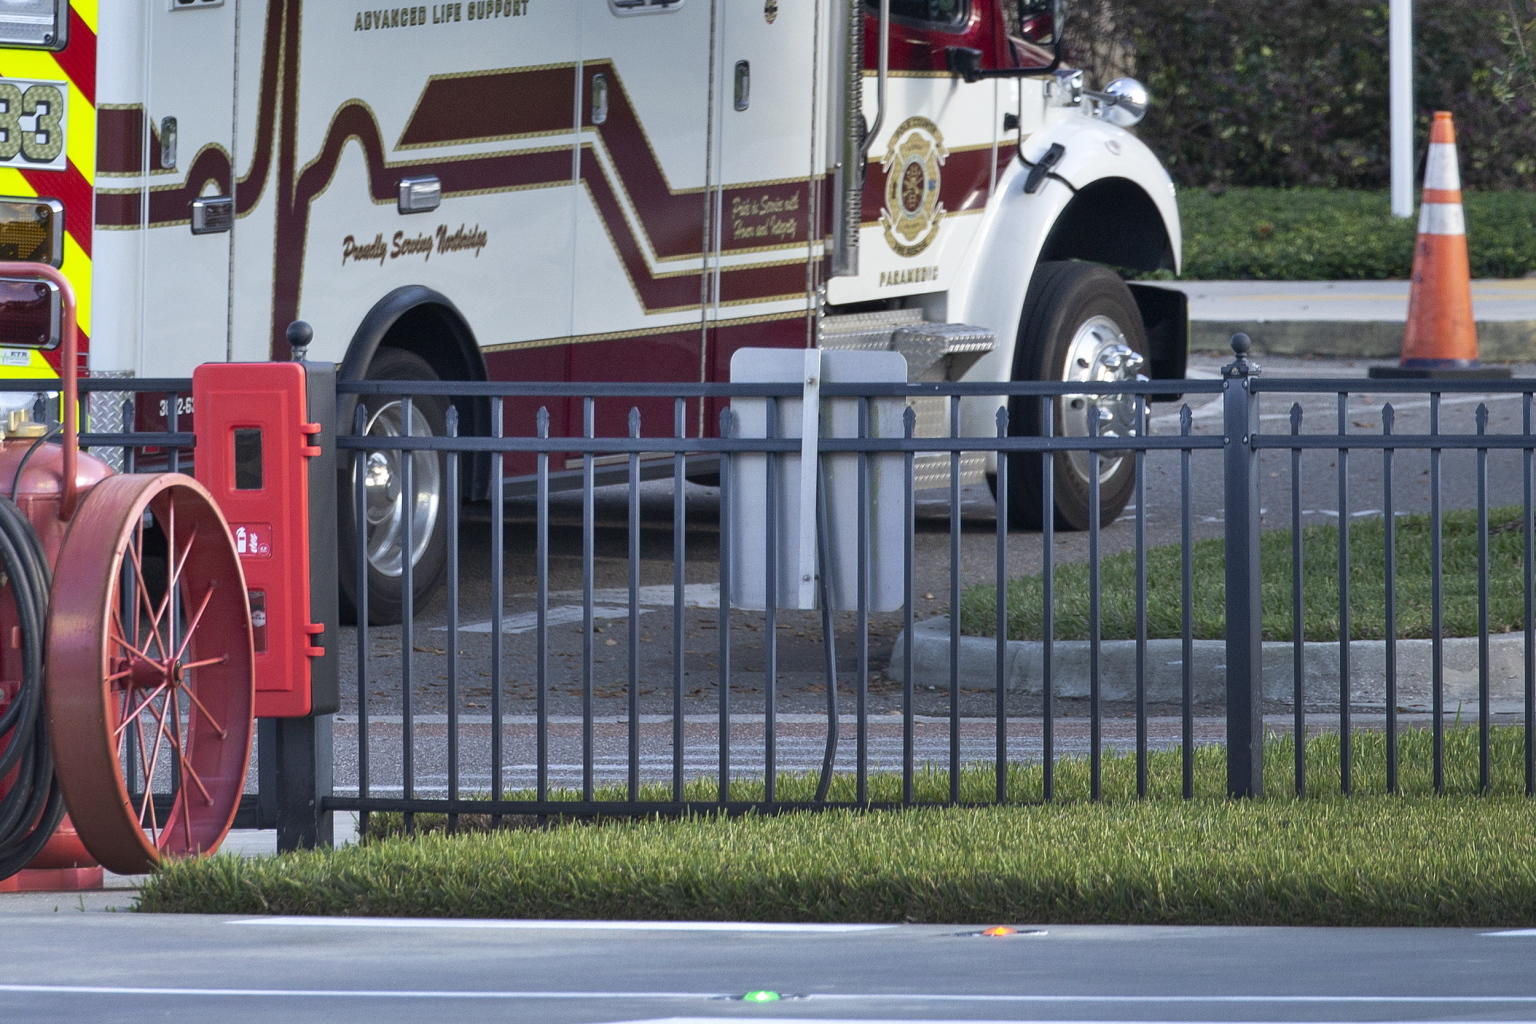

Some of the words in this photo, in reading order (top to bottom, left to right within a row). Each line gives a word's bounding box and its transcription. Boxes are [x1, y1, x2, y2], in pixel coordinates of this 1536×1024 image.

[354, 6, 426, 32] ADVANCED
[433, 2, 462, 24] LIFE
[342, 233, 387, 267] Proudly
[390, 230, 433, 262] Serving
[879, 265, 939, 288] PARAMEDIC
